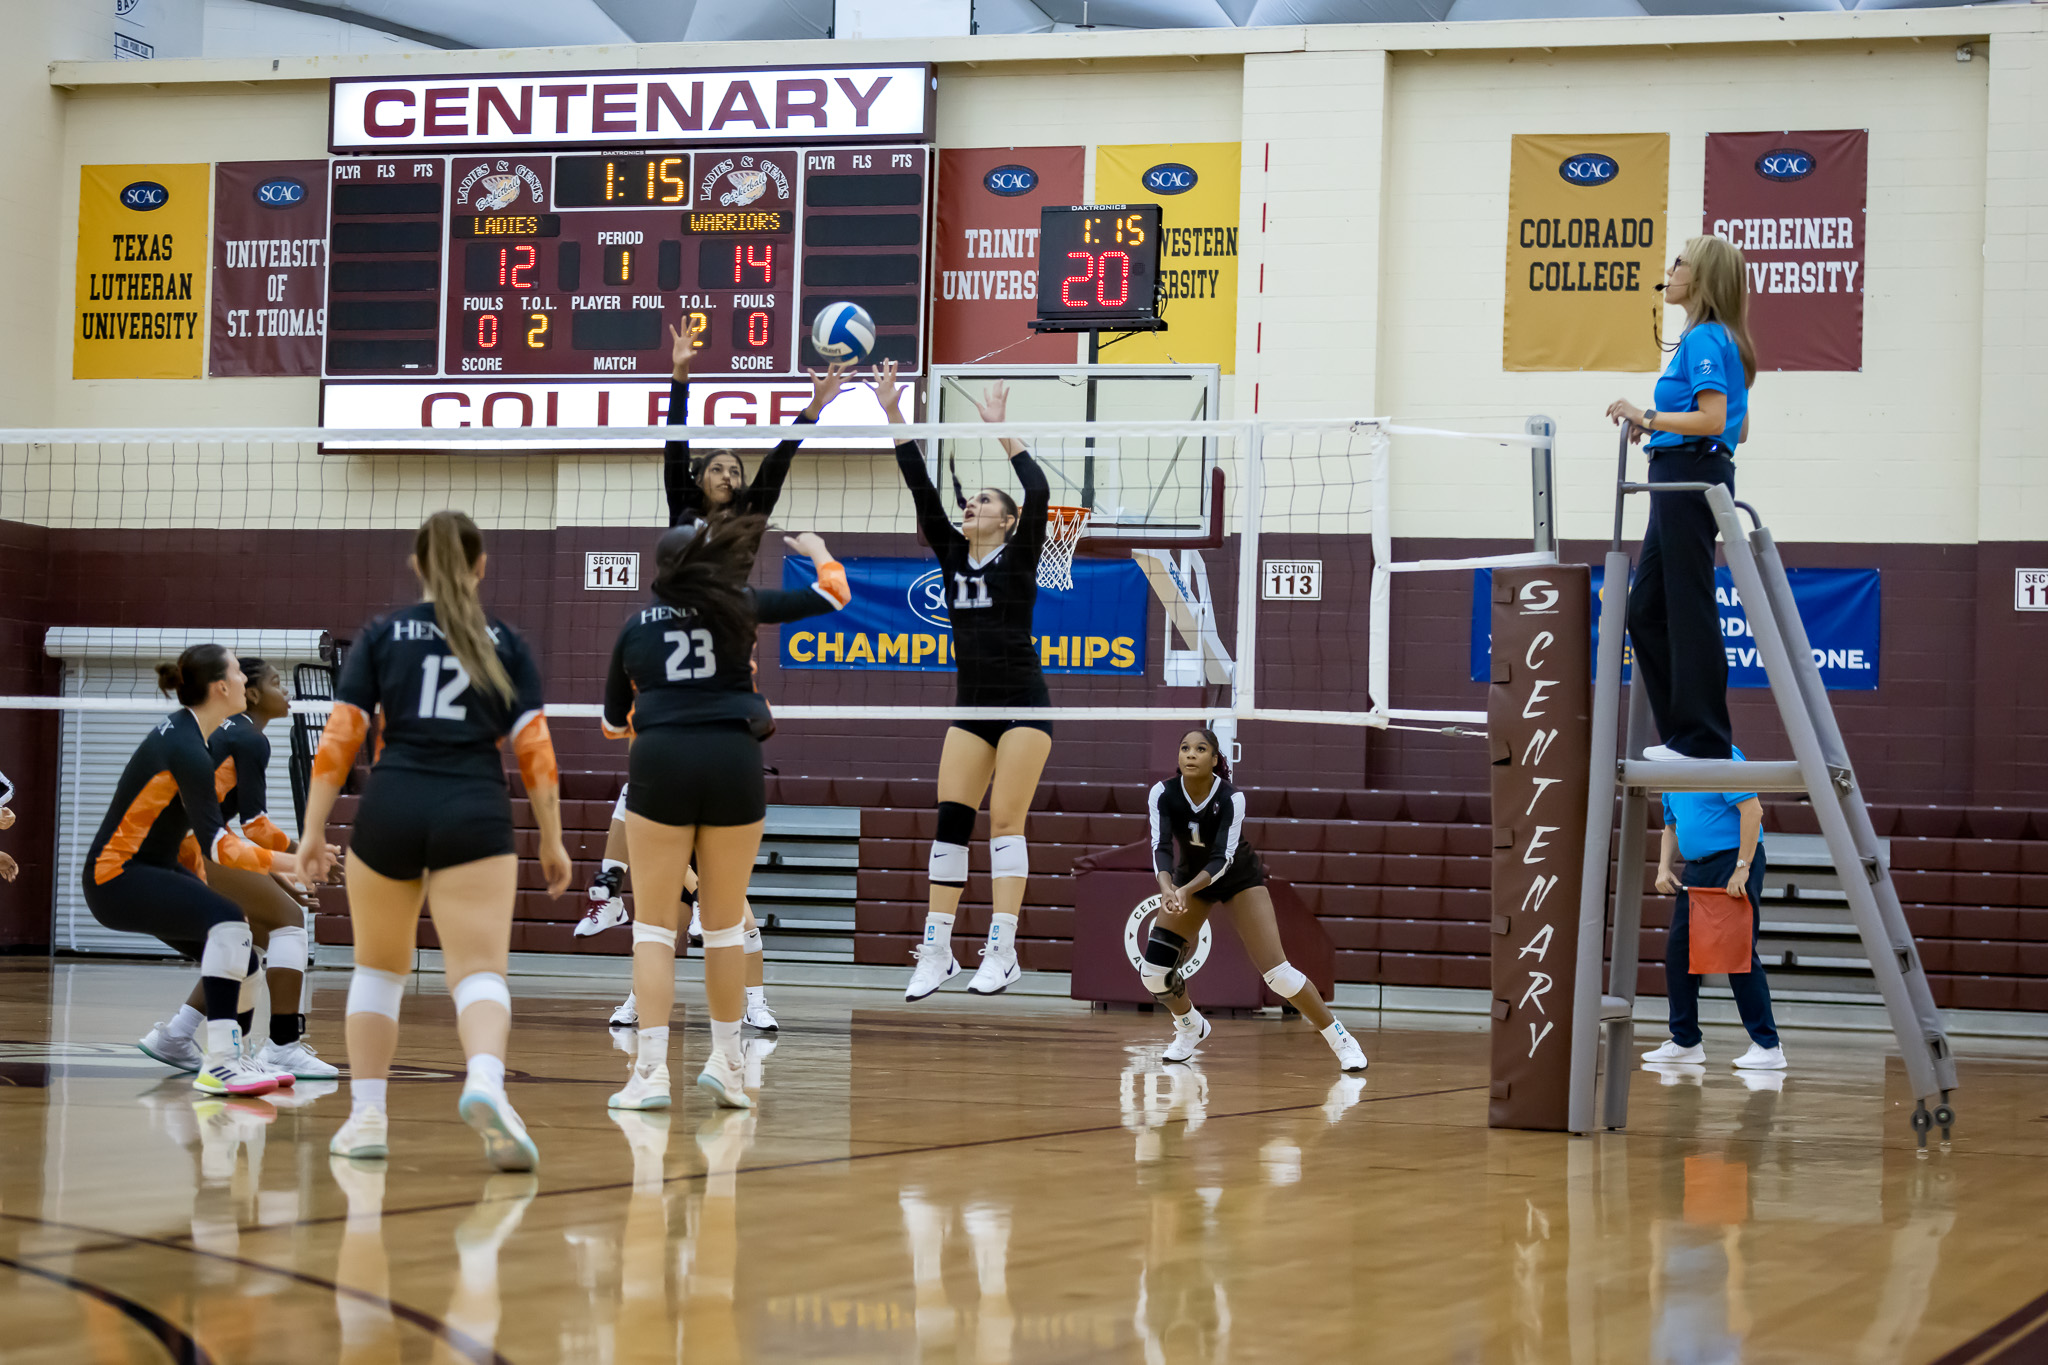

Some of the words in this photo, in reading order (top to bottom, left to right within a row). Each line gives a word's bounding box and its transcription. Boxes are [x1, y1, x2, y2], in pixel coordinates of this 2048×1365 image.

[364, 76, 893, 138] CENTENARY
[336, 165, 361, 179] PLYR
[377, 164, 396, 178] FLS
[413, 163, 433, 177] PTS
[808, 155, 836, 170] PLYR
[852, 155, 872, 169] FLS
[891, 153, 913, 168] PTS
[1567, 161, 1611, 179] SCAC
[1763, 156, 1808, 175] SCAC
[457, 163, 490, 205] LADIES
[496, 160, 509, 172] &
[515, 164, 543, 204] GENTS
[605, 158, 684, 202] 1:15
[701, 159, 734, 201] LADIES
[741, 156, 753, 167] &
[760, 160, 789, 199] GENTS
[720, 171, 767, 207] Basketball
[991, 173, 1031, 190] SCAC
[1150, 170, 1190, 188] SCAC
[127, 189, 162, 204] SCAC
[260, 184, 301, 201] SCAC
[475, 175, 521, 212] Basketball
[474, 216, 538, 235] LADIES
[690, 212, 781, 232] WARRIORS
[1084, 214, 1145, 246] 1:15
[1520, 218, 1654, 248] COLORADO
[1713, 217, 1854, 251] SCHREINER
[113, 234, 173, 261] TEXAS
[597, 230, 644, 246] PERIOD
[964, 228, 1041, 259] TRINIT
[499, 245, 536, 288] 12
[621, 250, 630, 281] 1
[734, 244, 773, 283] 14
[1529, 261, 1641, 292] COLLEGE
[1747, 260, 1860, 294] IVERSITY
[89, 273, 192, 300] LUTHERAN
[267, 274, 288, 302] OF
[942, 269, 1039, 300] UNIVERS
[1061, 250, 1129, 307] 20
[1158, 269, 1219, 299] ERSITY
[463, 297, 503, 311] FOULS
[521, 296, 557, 310] T.O.L.
[571, 296, 621, 310] PLAYER
[632, 295, 665, 309] FOUL
[680, 295, 717, 309] T.O.L.
[733, 294, 775, 308] FOULS
[82, 312, 198, 339] UNIVERSITY
[227, 309, 252, 337] ST.
[256, 308, 325, 337] THOMAS
[478, 314, 498, 348] 0
[527, 314, 548, 348] 2
[748, 312, 769, 346] 0
[461, 357, 502, 371] SCORE
[593, 357, 637, 370] MATCH
[731, 356, 773, 370] SCORE
[593, 556, 632, 566] SECTION
[1271, 564, 1314, 574] SECTION
[593, 566, 629, 585] 114
[1271, 575, 1312, 595] 113
[2024, 573, 2048, 584] SEC
[953, 572, 993, 609] 11
[394, 619, 500, 646] HENX
[664, 628, 717, 682] 23
[788, 631, 1136, 668] CHAMPIHIPS
[1725, 647, 1870, 669] EVONE.
[418, 655, 471, 721] 12
[1188, 821, 1206, 848] 1
[1517, 630, 1563, 1059] CENTENARY
